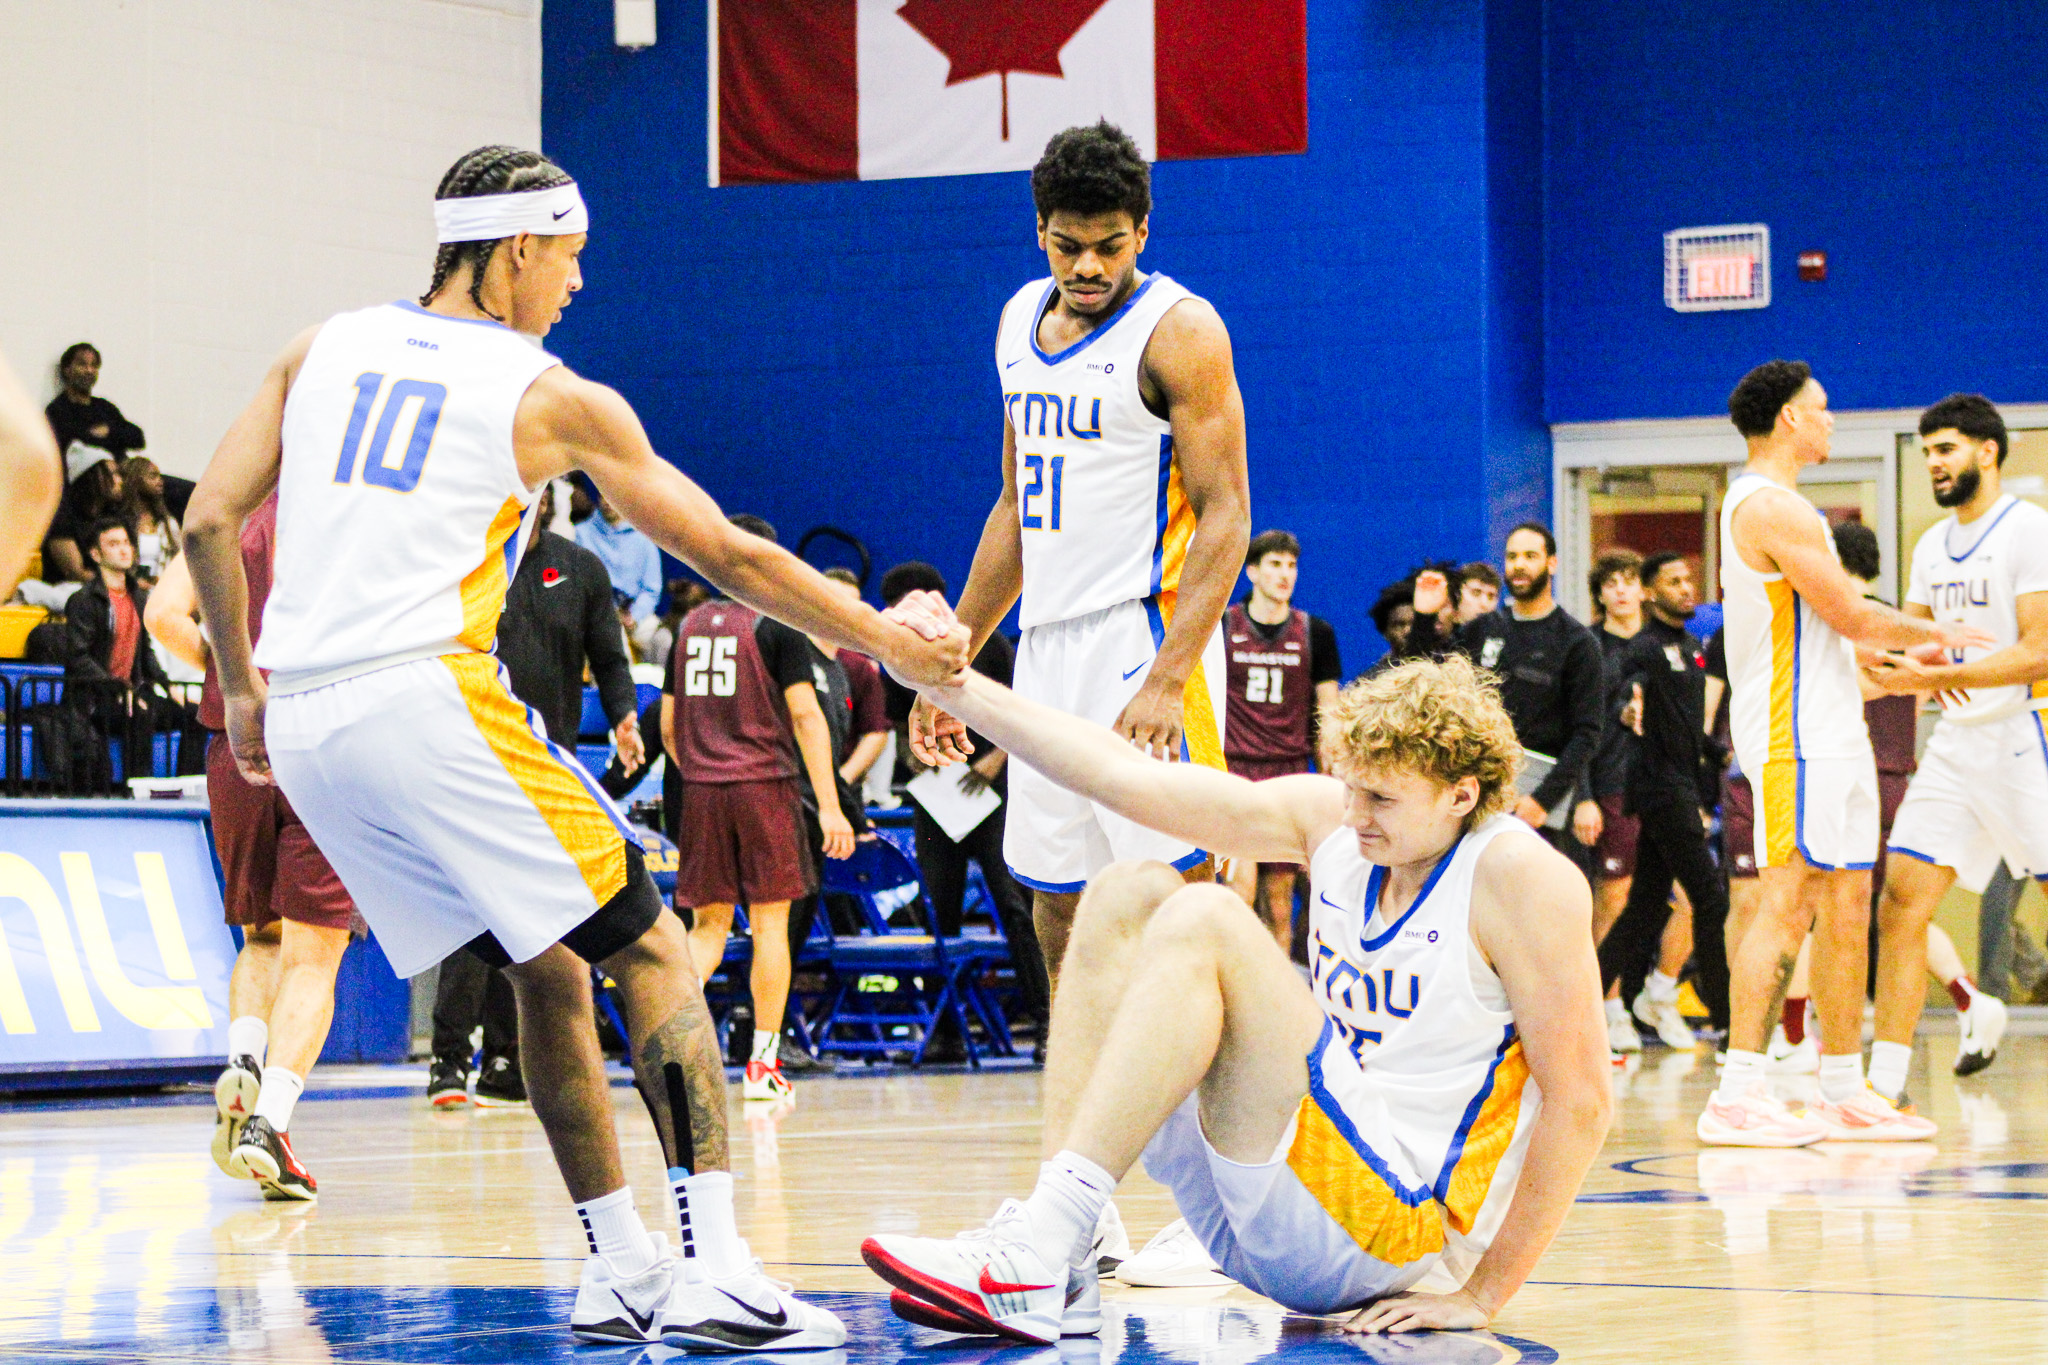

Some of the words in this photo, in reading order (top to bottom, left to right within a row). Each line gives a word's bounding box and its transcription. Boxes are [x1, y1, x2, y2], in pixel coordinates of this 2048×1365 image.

[1697, 263, 1743, 295] EXIT
[406, 338, 439, 351] OUA
[331, 370, 450, 496] 10
[1004, 391, 1103, 441] TMU
[1022, 453, 1067, 532] 21
[1931, 579, 1990, 612] TMU
[685, 635, 738, 697] 25
[1246, 666, 1284, 704] 21
[1404, 929, 1426, 939] BMO
